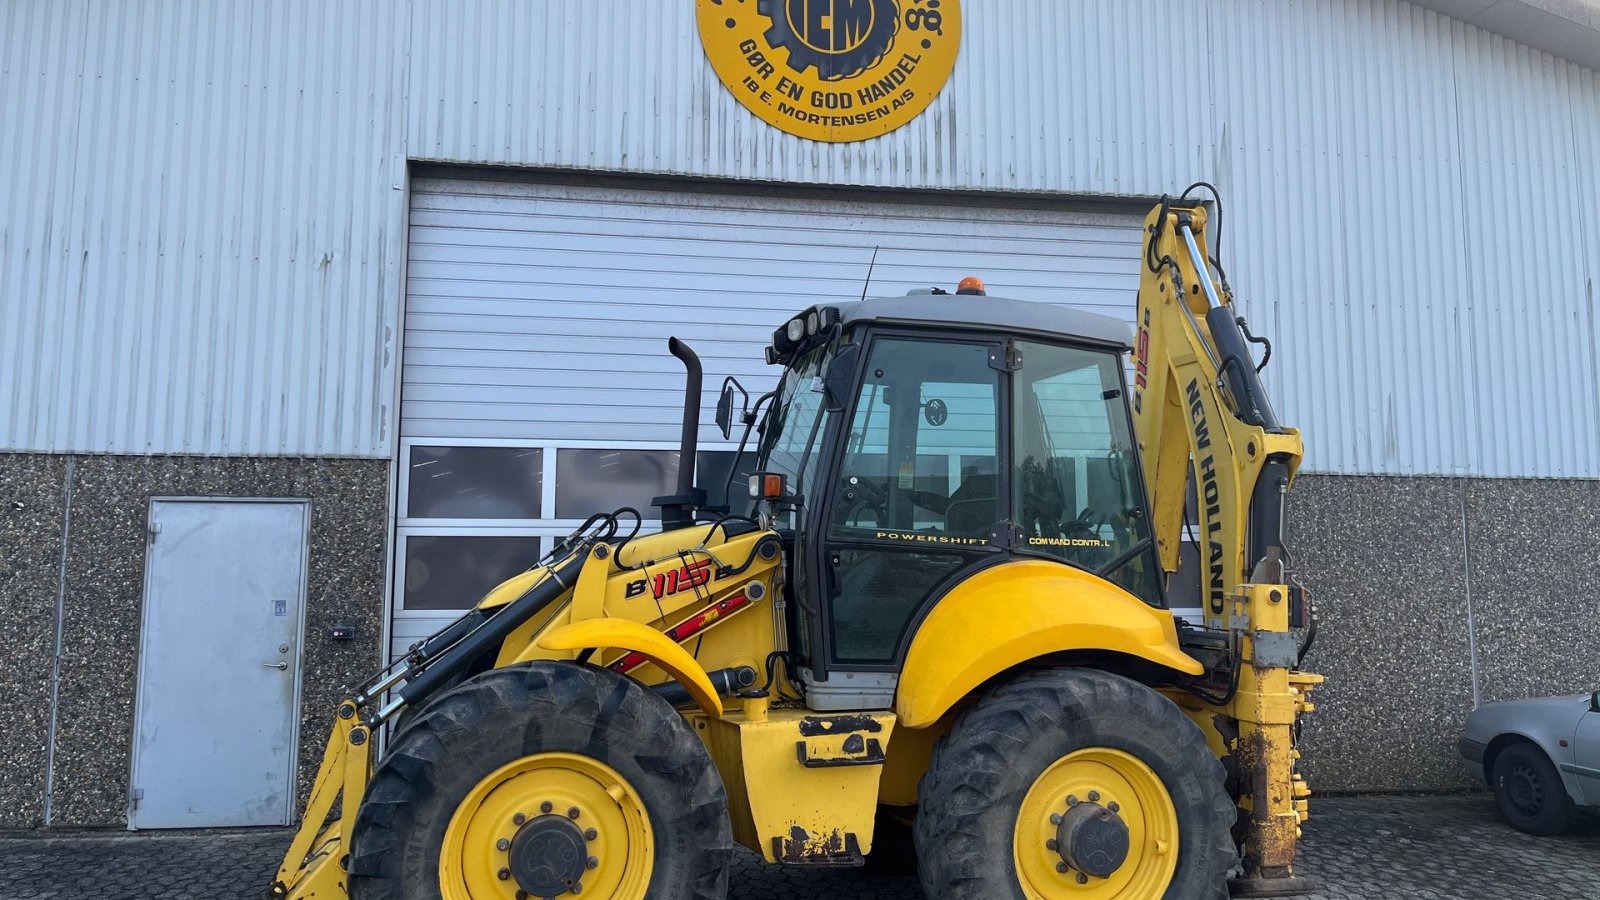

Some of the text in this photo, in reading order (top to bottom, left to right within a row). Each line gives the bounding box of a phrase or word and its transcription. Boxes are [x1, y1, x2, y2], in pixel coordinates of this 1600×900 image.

[739, 38, 922, 110] GØR EN GOD HANDEL
[742, 75, 760, 93] IB
[777, 104, 890, 127] MORTENSEN
[1185, 377, 1224, 616] NEW HOLLAND
[876, 532, 988, 546] POWERSHIFT
